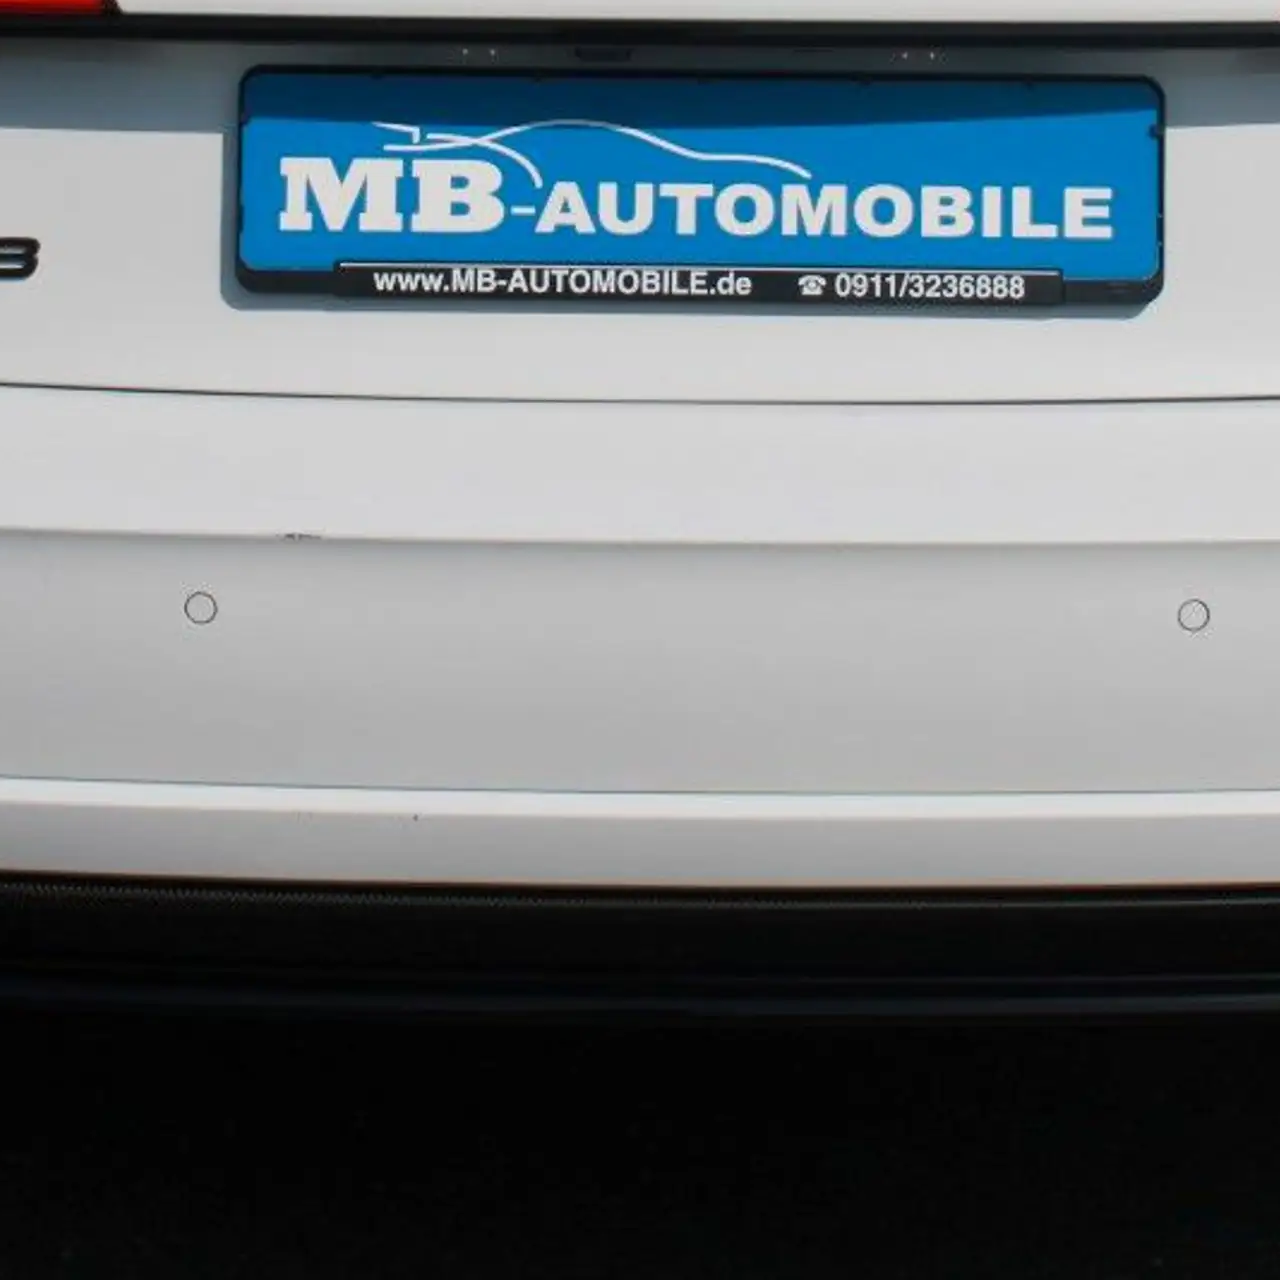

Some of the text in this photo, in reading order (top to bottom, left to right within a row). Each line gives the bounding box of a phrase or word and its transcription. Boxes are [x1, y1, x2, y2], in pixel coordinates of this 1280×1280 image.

[278, 156, 1115, 240] MB-AUTOMOBILE
[372, 267, 1026, 299] www.MB-AUTOMOBILE.de 0911/3236888
